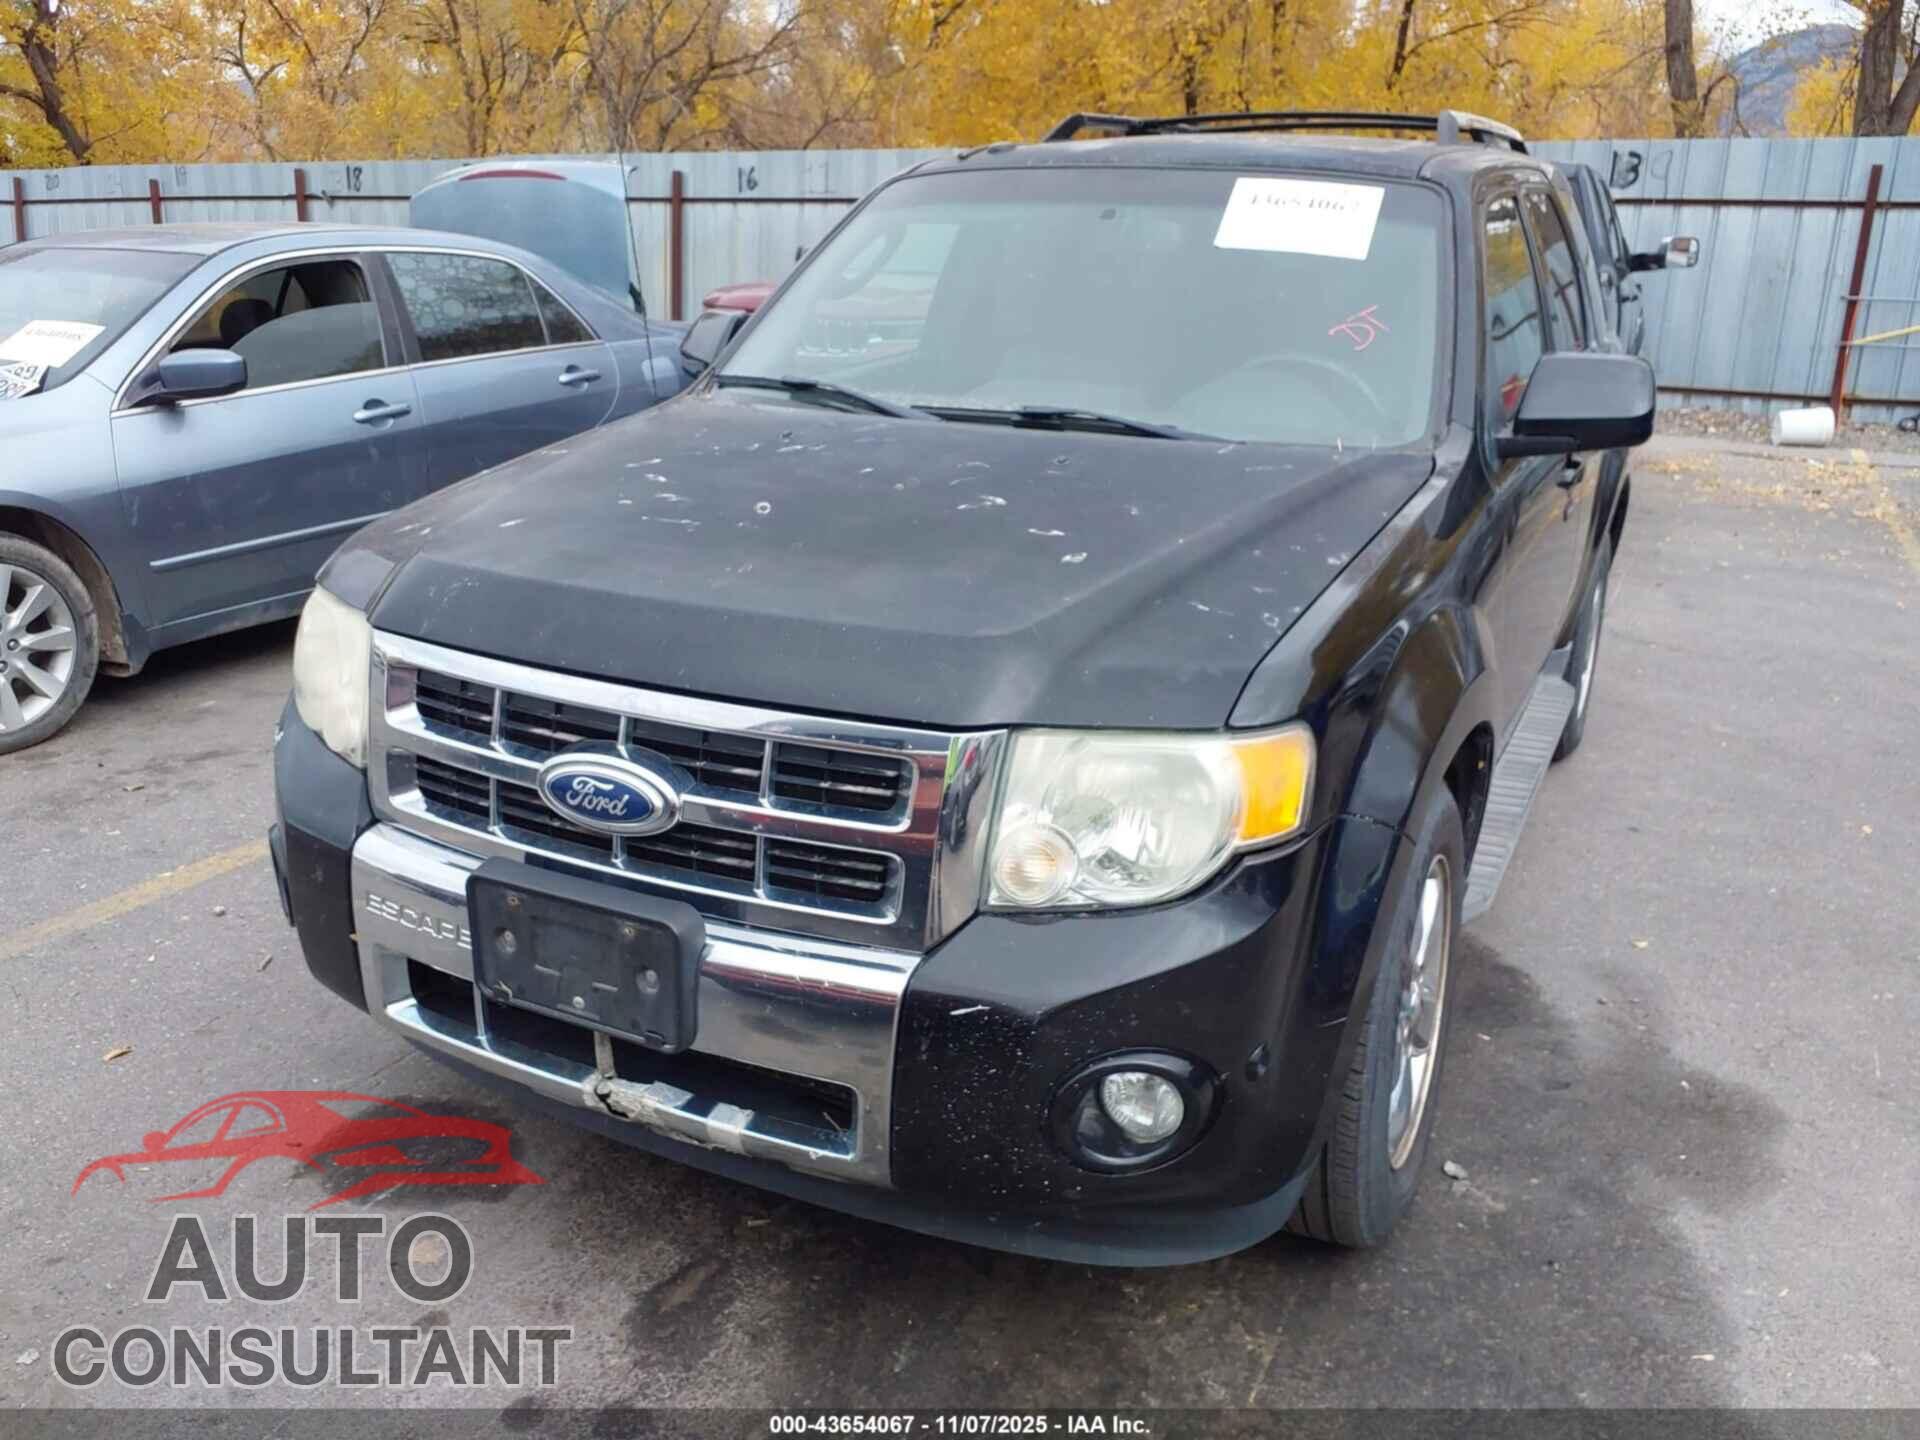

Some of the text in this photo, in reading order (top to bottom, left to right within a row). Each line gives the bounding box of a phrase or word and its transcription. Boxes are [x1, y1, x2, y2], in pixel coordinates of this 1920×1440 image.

[345, 165, 362, 192] 18
[737, 166, 759, 193] 16
[565, 776, 631, 816] Ford
